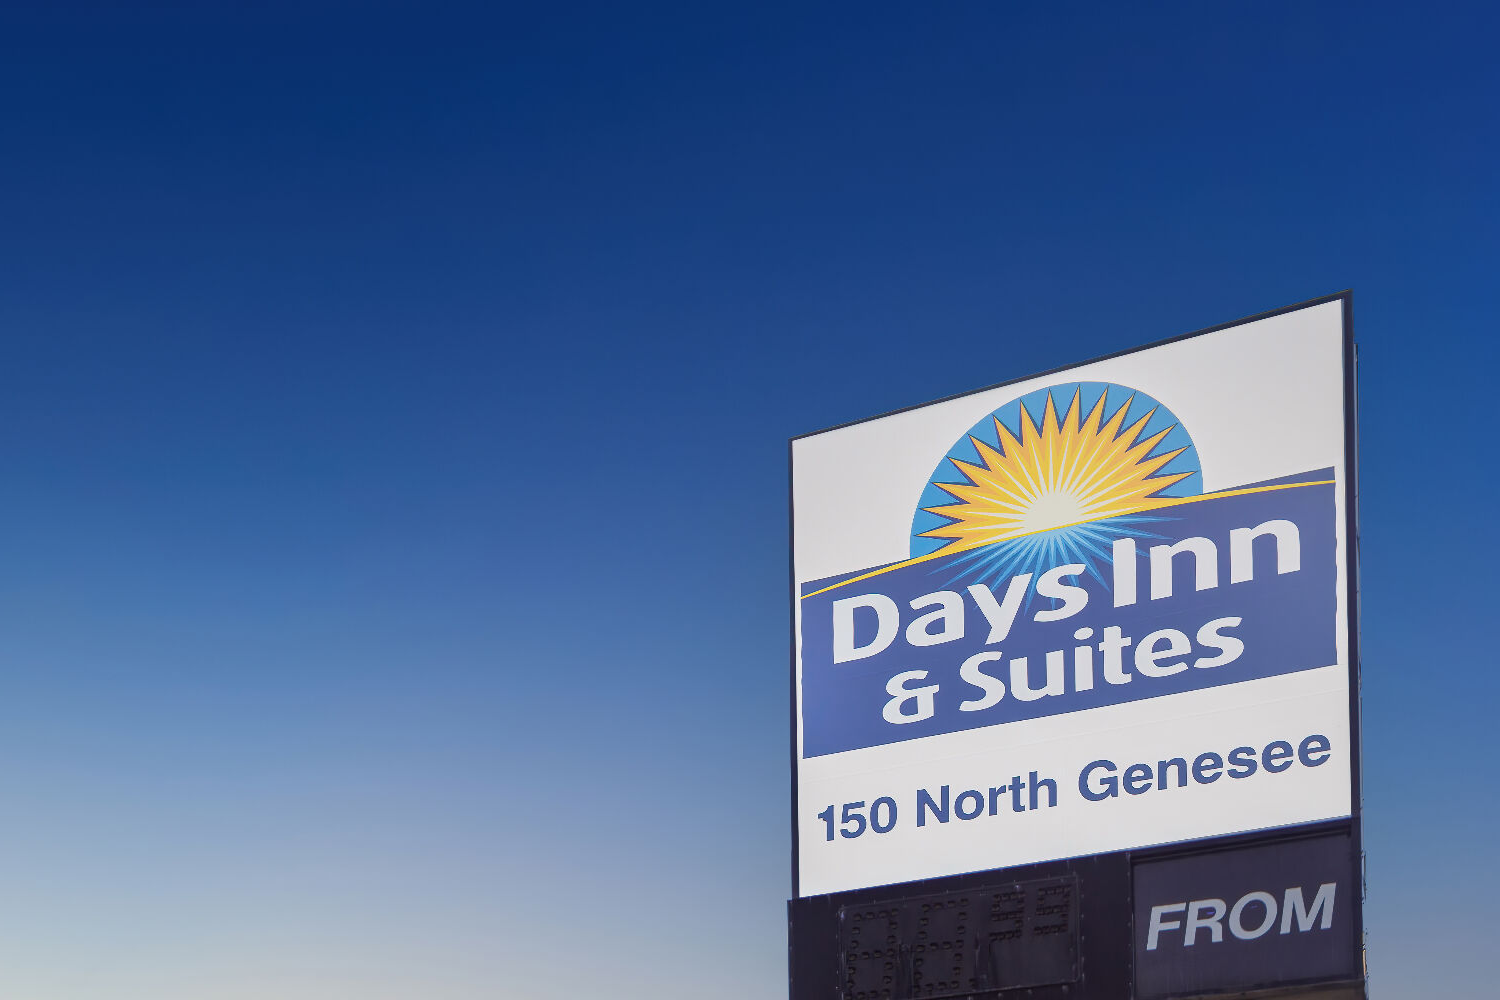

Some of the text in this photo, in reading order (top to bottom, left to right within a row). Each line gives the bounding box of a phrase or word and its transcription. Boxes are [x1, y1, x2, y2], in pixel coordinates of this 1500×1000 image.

[832, 519, 1301, 665] Days Inn
[882, 616, 1245, 725] & Suites
[817, 734, 1331, 841] 150 North Genesee
[1146, 882, 1337, 951] FROM
